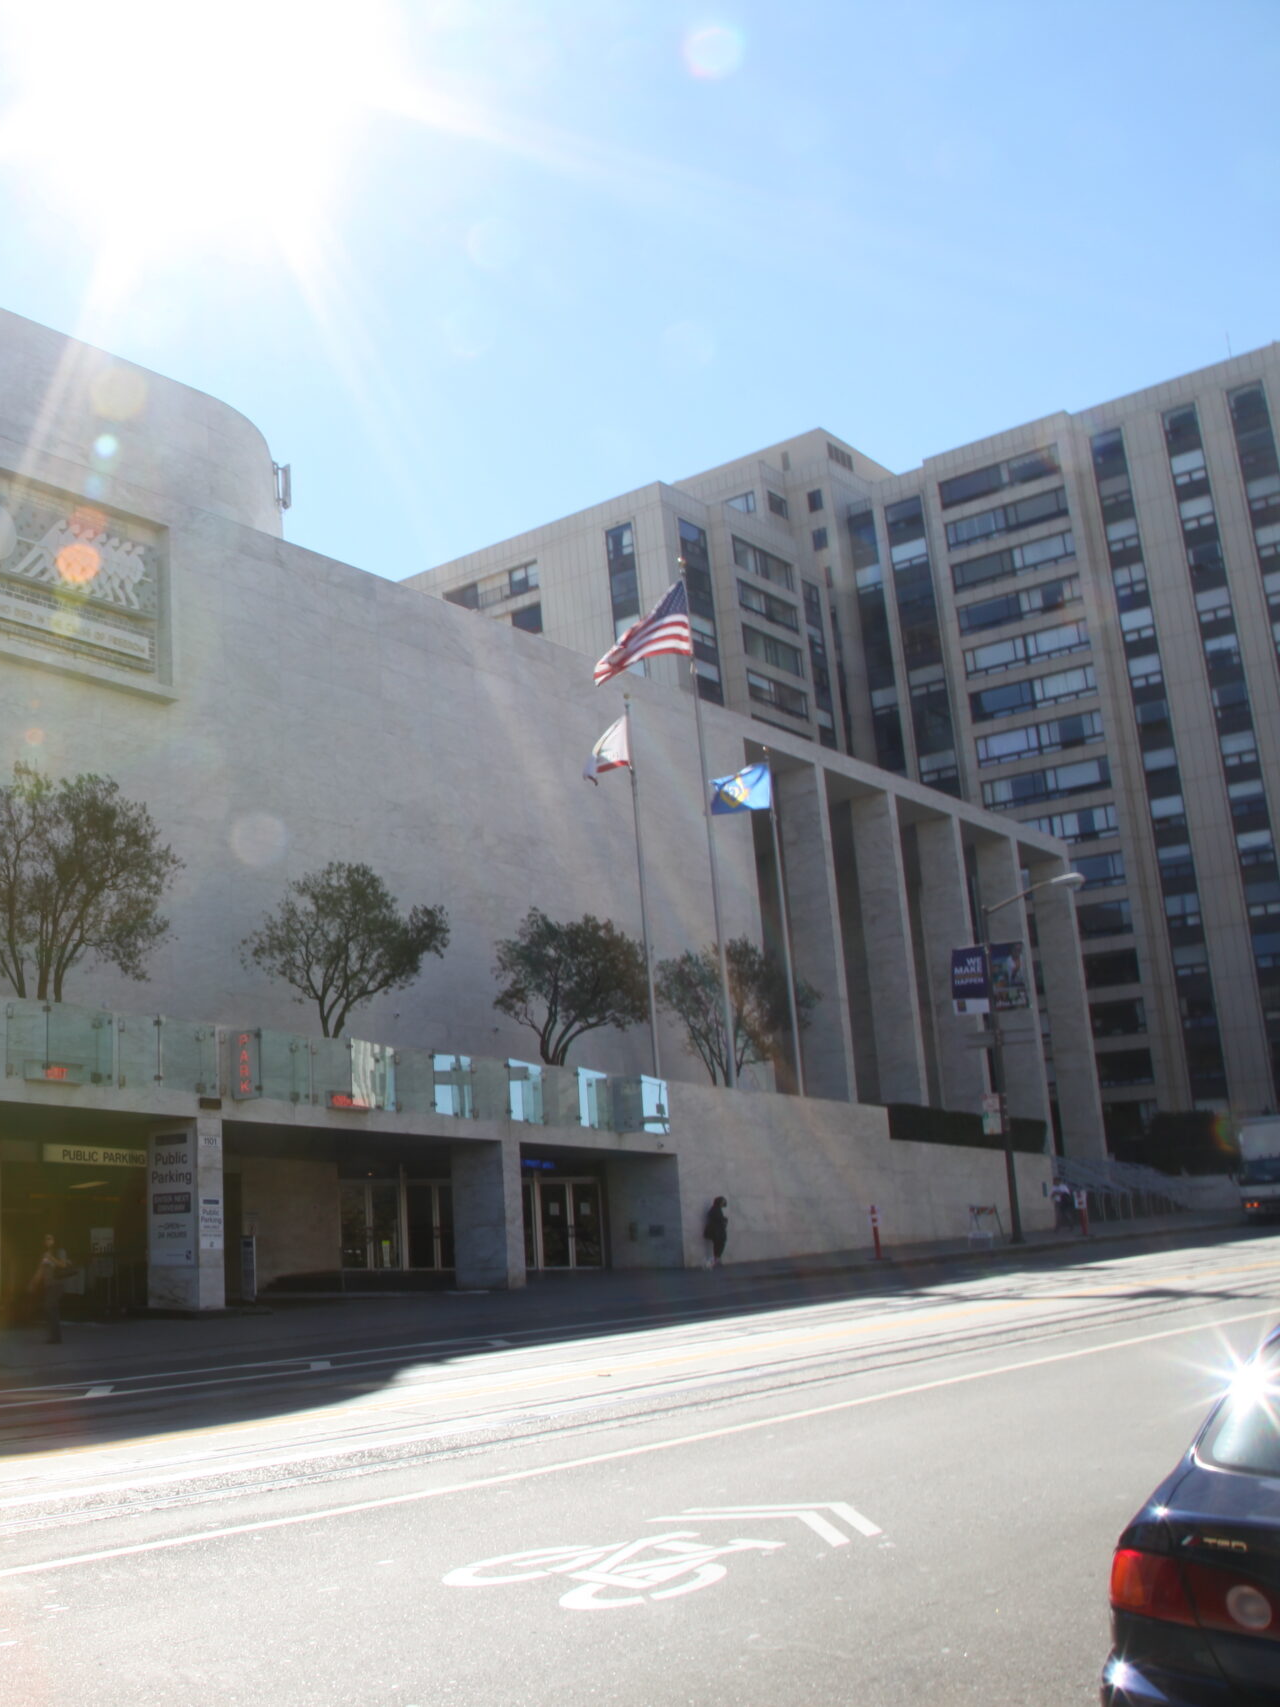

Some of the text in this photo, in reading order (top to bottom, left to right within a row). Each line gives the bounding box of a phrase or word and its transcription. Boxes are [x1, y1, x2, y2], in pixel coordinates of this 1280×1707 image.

[966, 956, 982, 967] WE
[955, 966, 982, 974] MAKE
[204, 1137, 217, 1145] 1101
[62, 1149, 146, 1164] PUBLIC PARKING
[155, 1151, 188, 1166] Public
[151, 1170, 192, 1185] Parking
[201, 1216, 222, 1224] Parking
